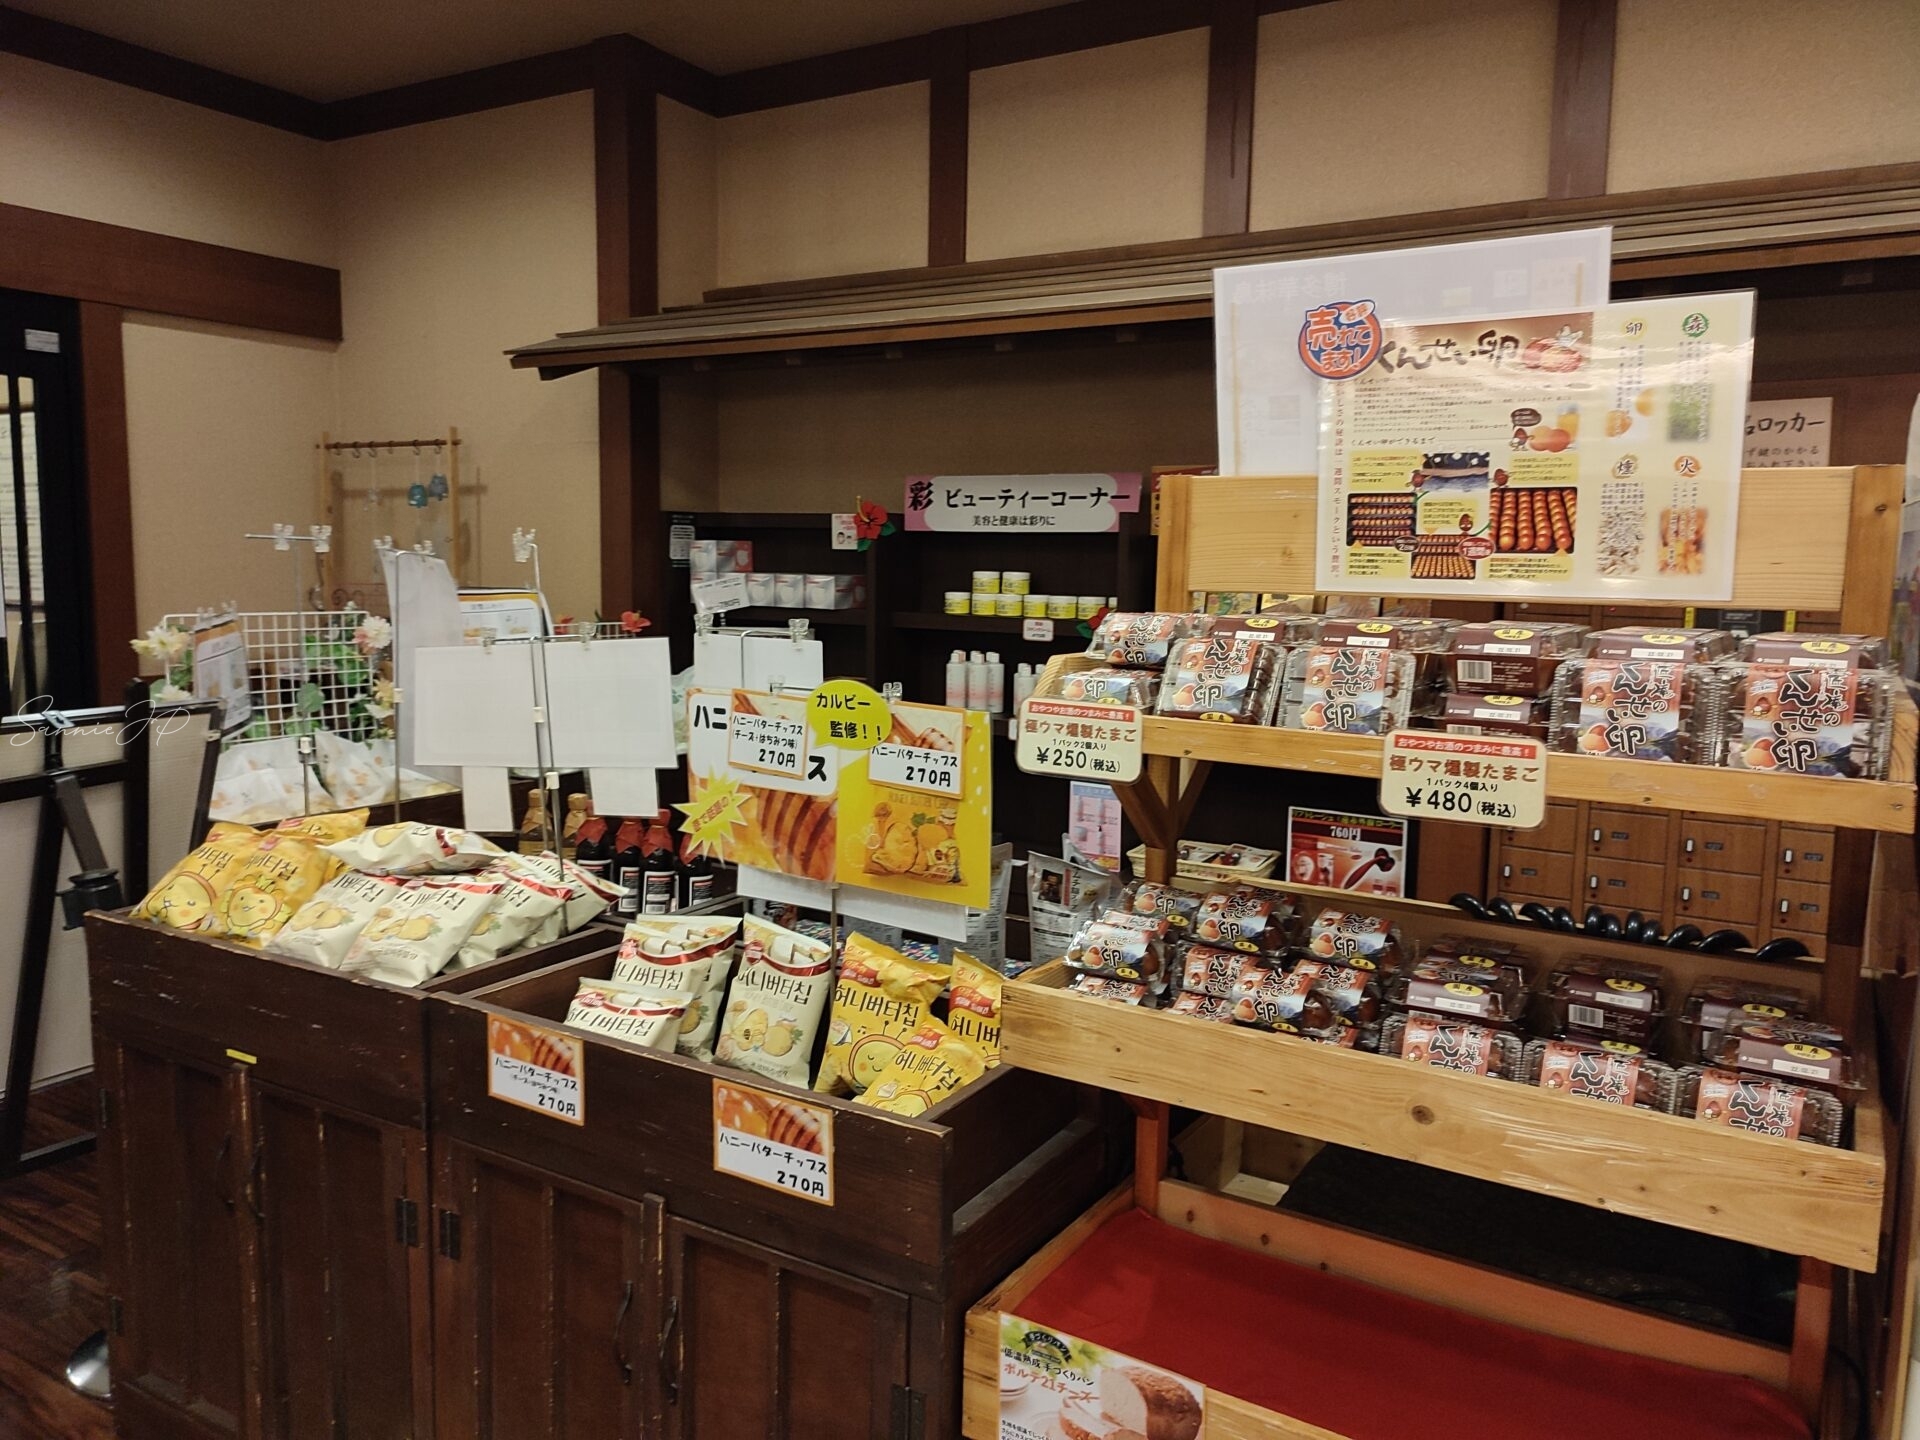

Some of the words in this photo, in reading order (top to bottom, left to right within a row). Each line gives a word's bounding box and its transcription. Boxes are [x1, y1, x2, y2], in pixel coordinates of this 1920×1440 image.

[1626, 322, 1643, 335] 卵
[1679, 458, 1695, 473] 火
[908, 481, 934, 511] 彩
[945, 486, 1131, 509] ビューティーコーナー
[815, 692, 871, 709] カルビー
[733, 715, 804, 737] ハニーバターチップス
[758, 748, 796, 768] 270円
[872, 745, 958, 767] ハニーバターチップス
[905, 766, 952, 788] 270円
[834, 983, 919, 1028] 허니버터칩
[494, 1056, 578, 1092] ハニーバターチップス
[537, 1092, 577, 1117] 270円
[719, 1131, 829, 1176] ハニーバターチップス
[776, 1169, 826, 1198] 270円
